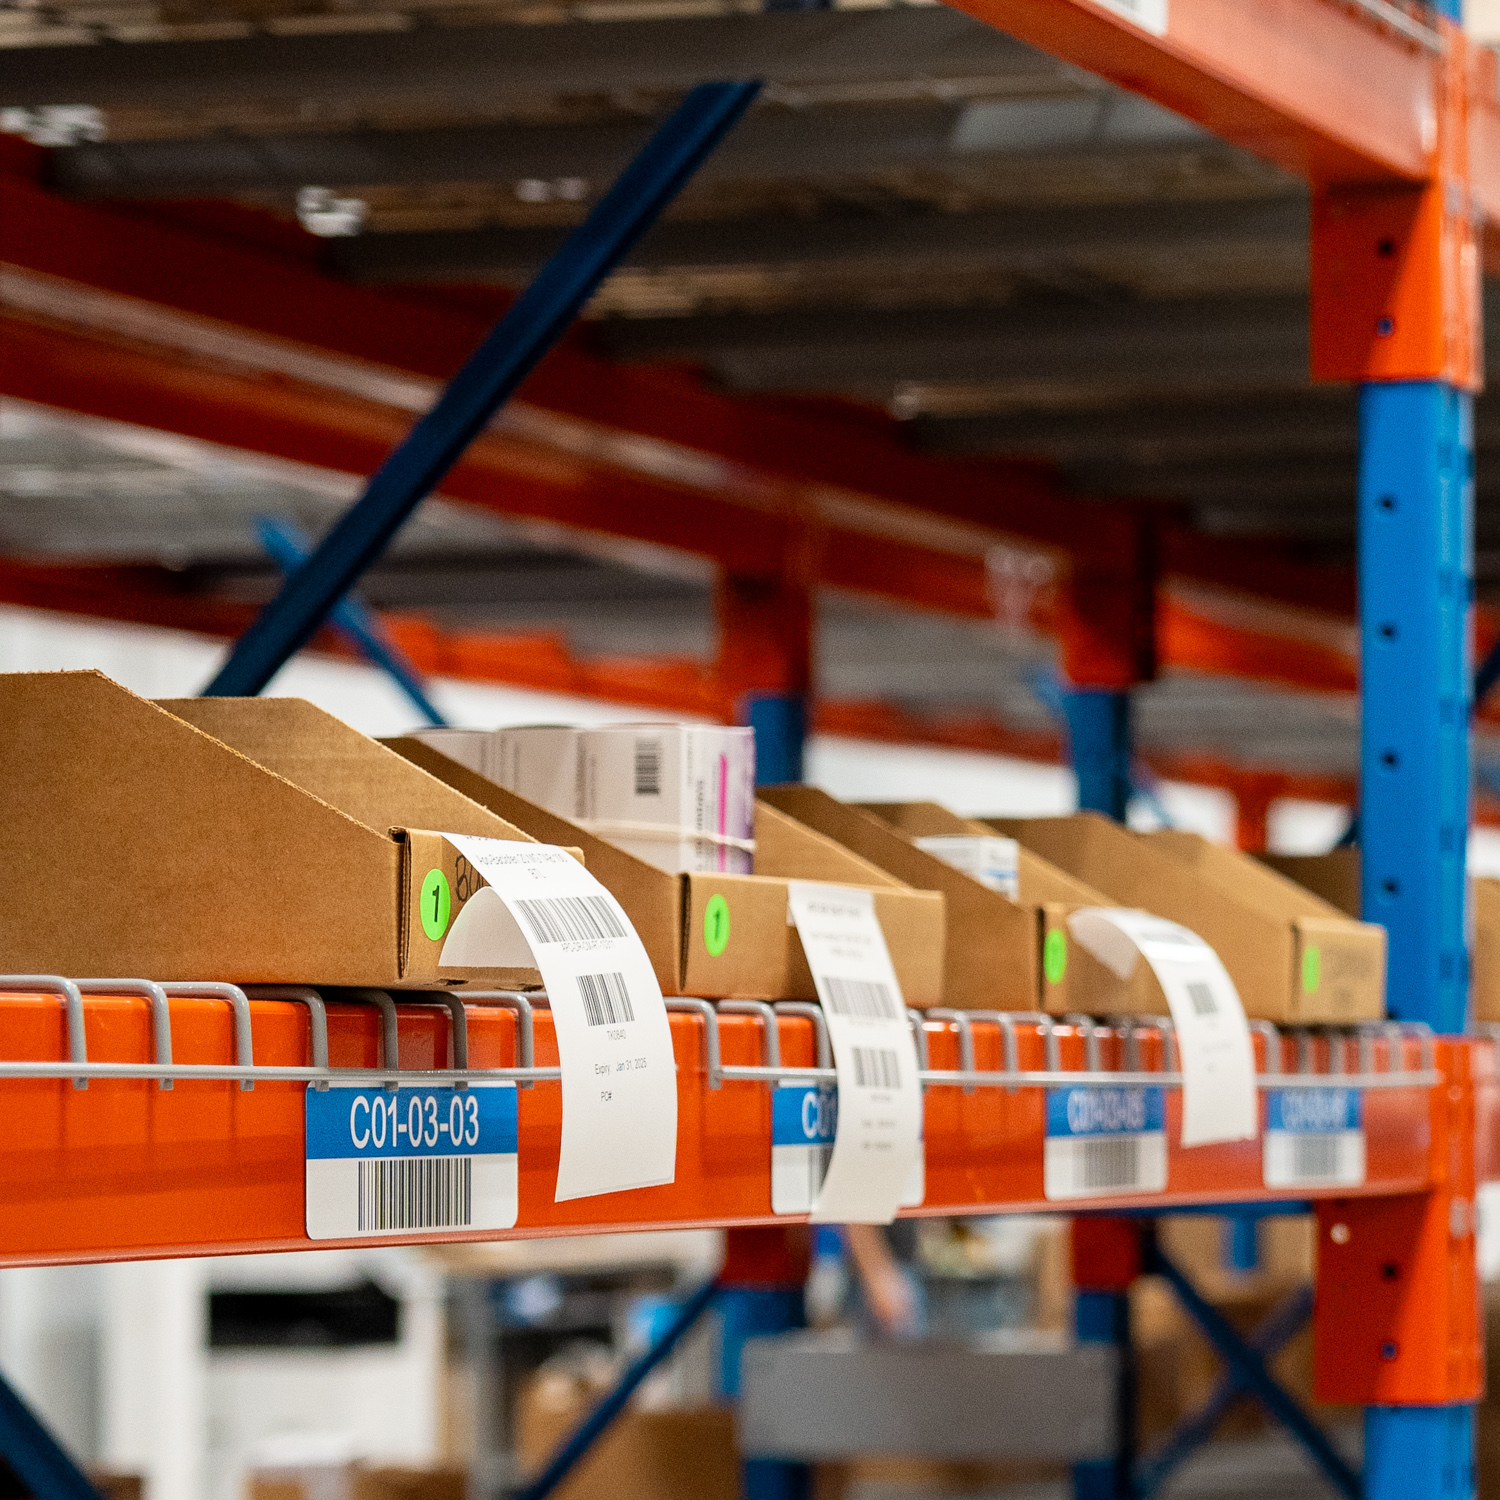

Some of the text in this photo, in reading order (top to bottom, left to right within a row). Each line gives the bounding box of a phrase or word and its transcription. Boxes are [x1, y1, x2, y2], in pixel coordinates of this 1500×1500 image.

[432, 884, 440, 923] 1
[594, 1063, 611, 1076] Expiry
[350, 1095, 480, 1149] C01-03-03
